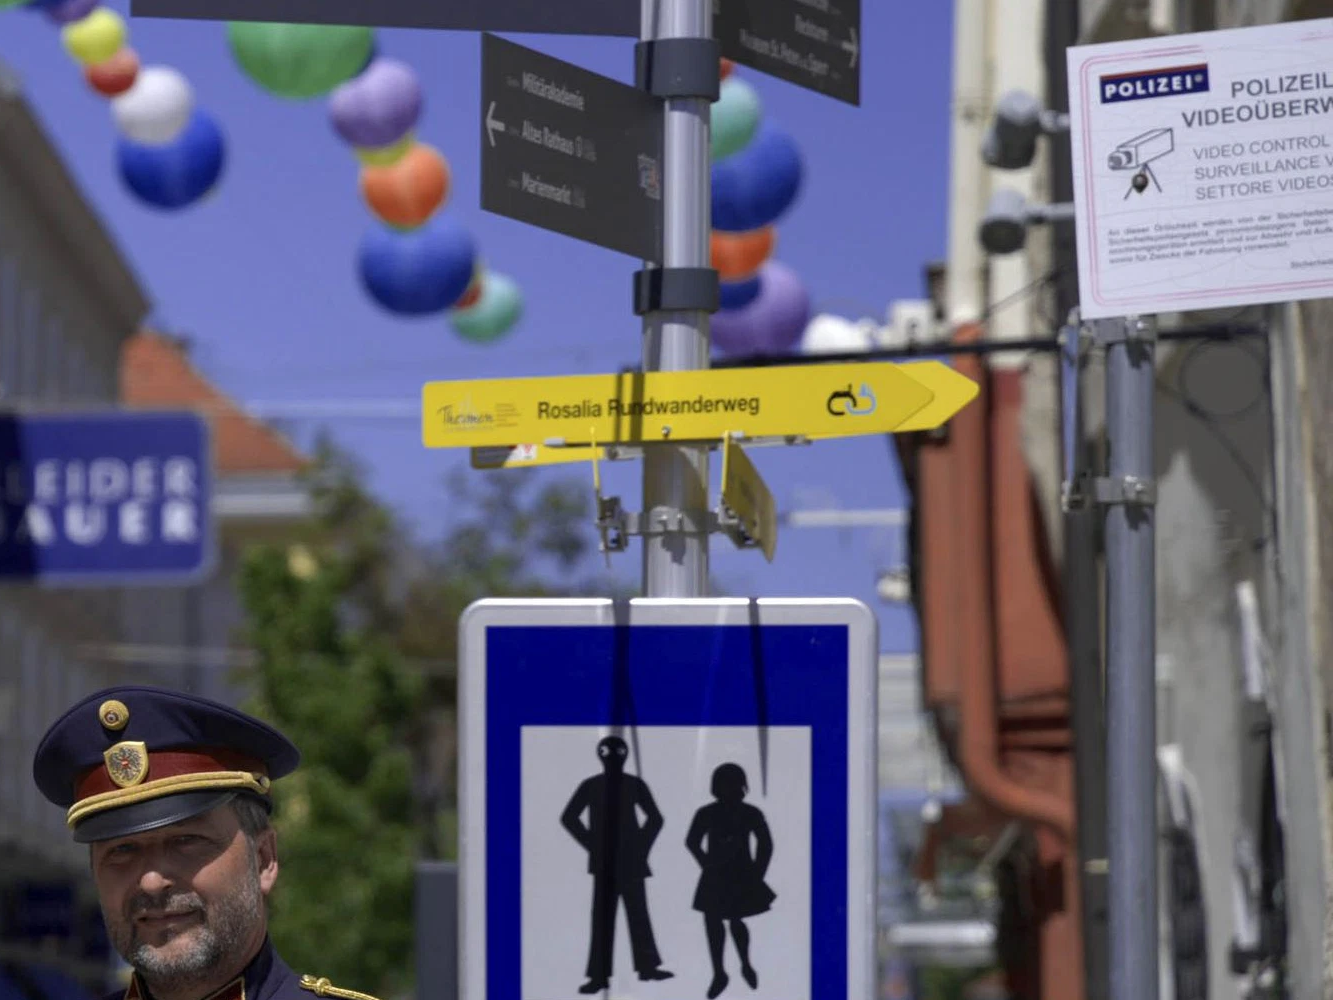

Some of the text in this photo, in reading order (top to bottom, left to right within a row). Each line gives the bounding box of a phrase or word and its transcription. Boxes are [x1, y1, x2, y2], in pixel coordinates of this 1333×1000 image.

[1193, 134, 1329, 161] VIDEO CONTROL
[1194, 154, 1320, 180] SURVEILLANCE
[1196, 180, 1273, 201] SETTORE
[537, 399, 602, 421] Rosalia
[607, 395, 760, 419] Rundwanderweg
